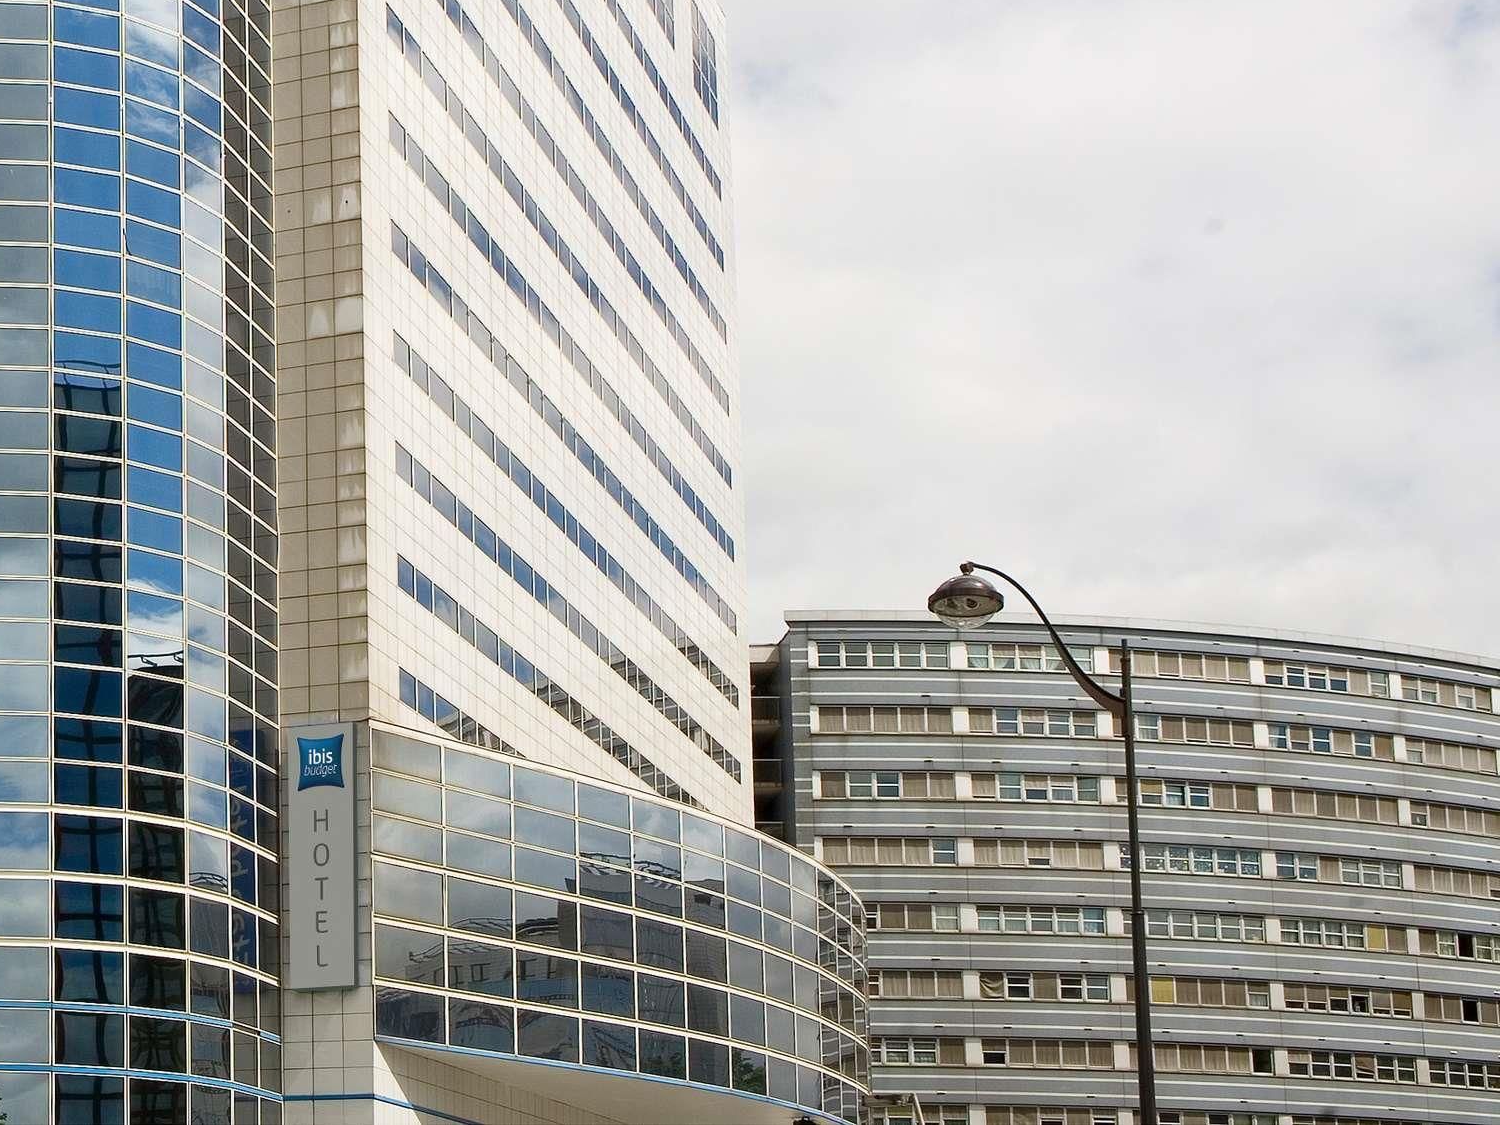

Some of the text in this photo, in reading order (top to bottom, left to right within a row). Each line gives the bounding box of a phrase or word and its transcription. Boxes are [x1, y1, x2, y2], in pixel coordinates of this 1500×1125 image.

[308, 748, 333, 765] ibis
[303, 764, 338, 777] budget
[312, 808, 330, 968] HOTEL
